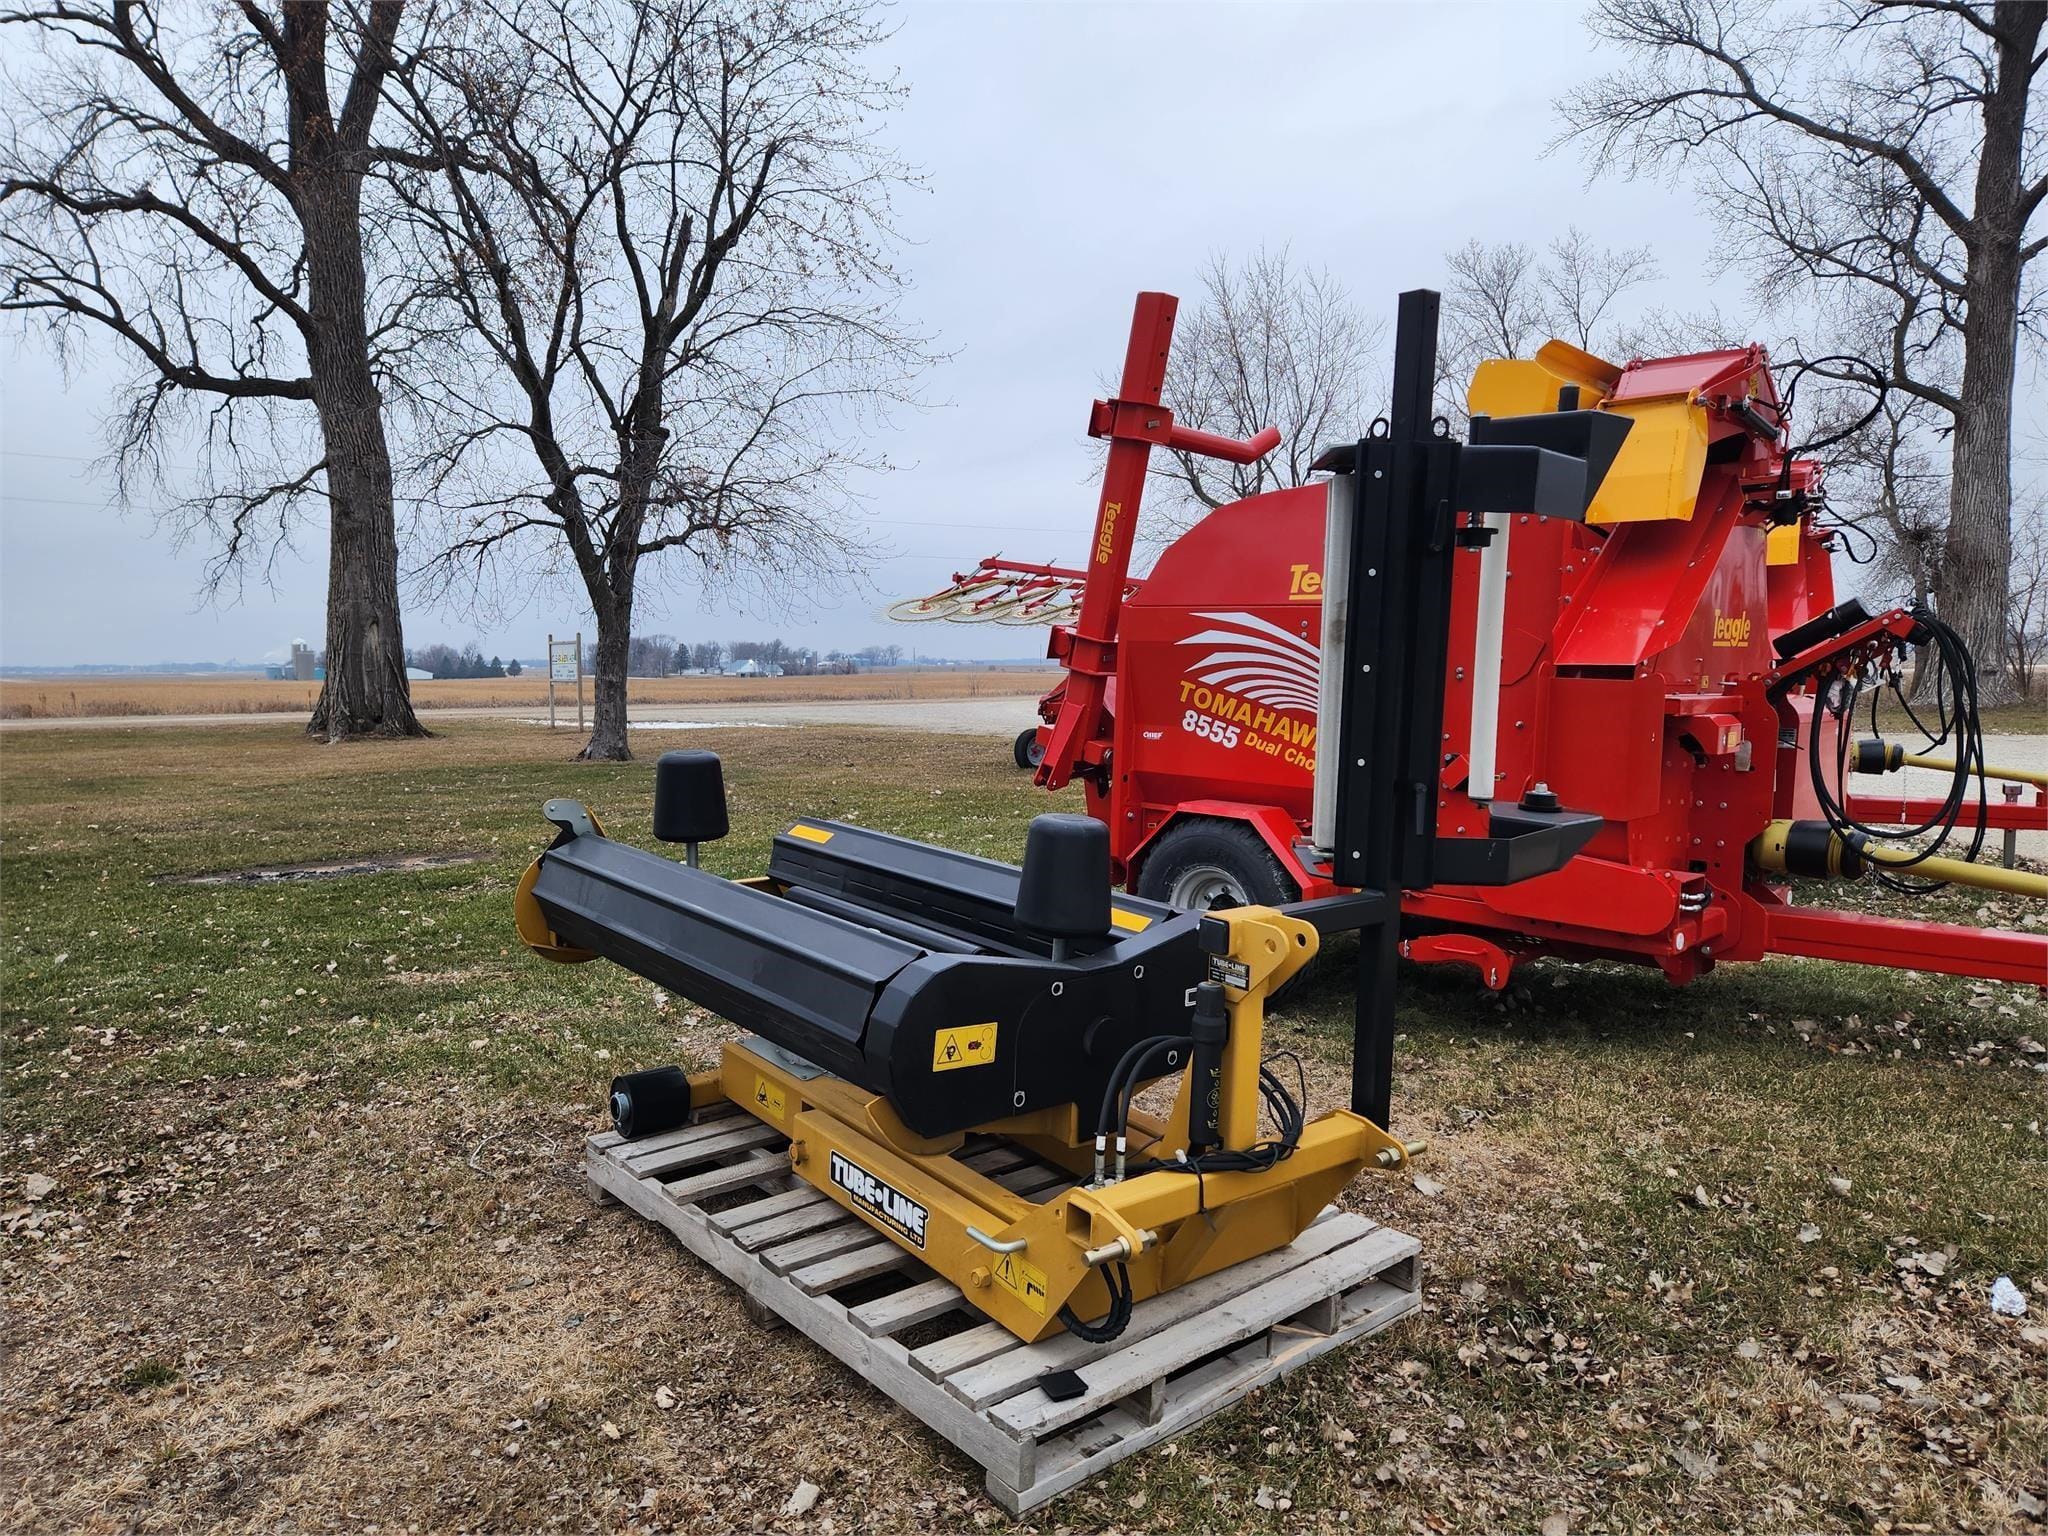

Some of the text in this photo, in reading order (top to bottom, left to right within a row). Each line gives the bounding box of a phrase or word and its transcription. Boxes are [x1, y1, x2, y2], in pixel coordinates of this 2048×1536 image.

[1097, 501, 1121, 564] Teagle
[1290, 564, 1323, 594] Te
[1713, 609, 1751, 647] Teagle
[1179, 680, 1317, 751] TOMAHAW
[1182, 710, 1316, 776] 8555 Dual Cho
[853, 1194, 923, 1245] MANUFACTURING LTD
